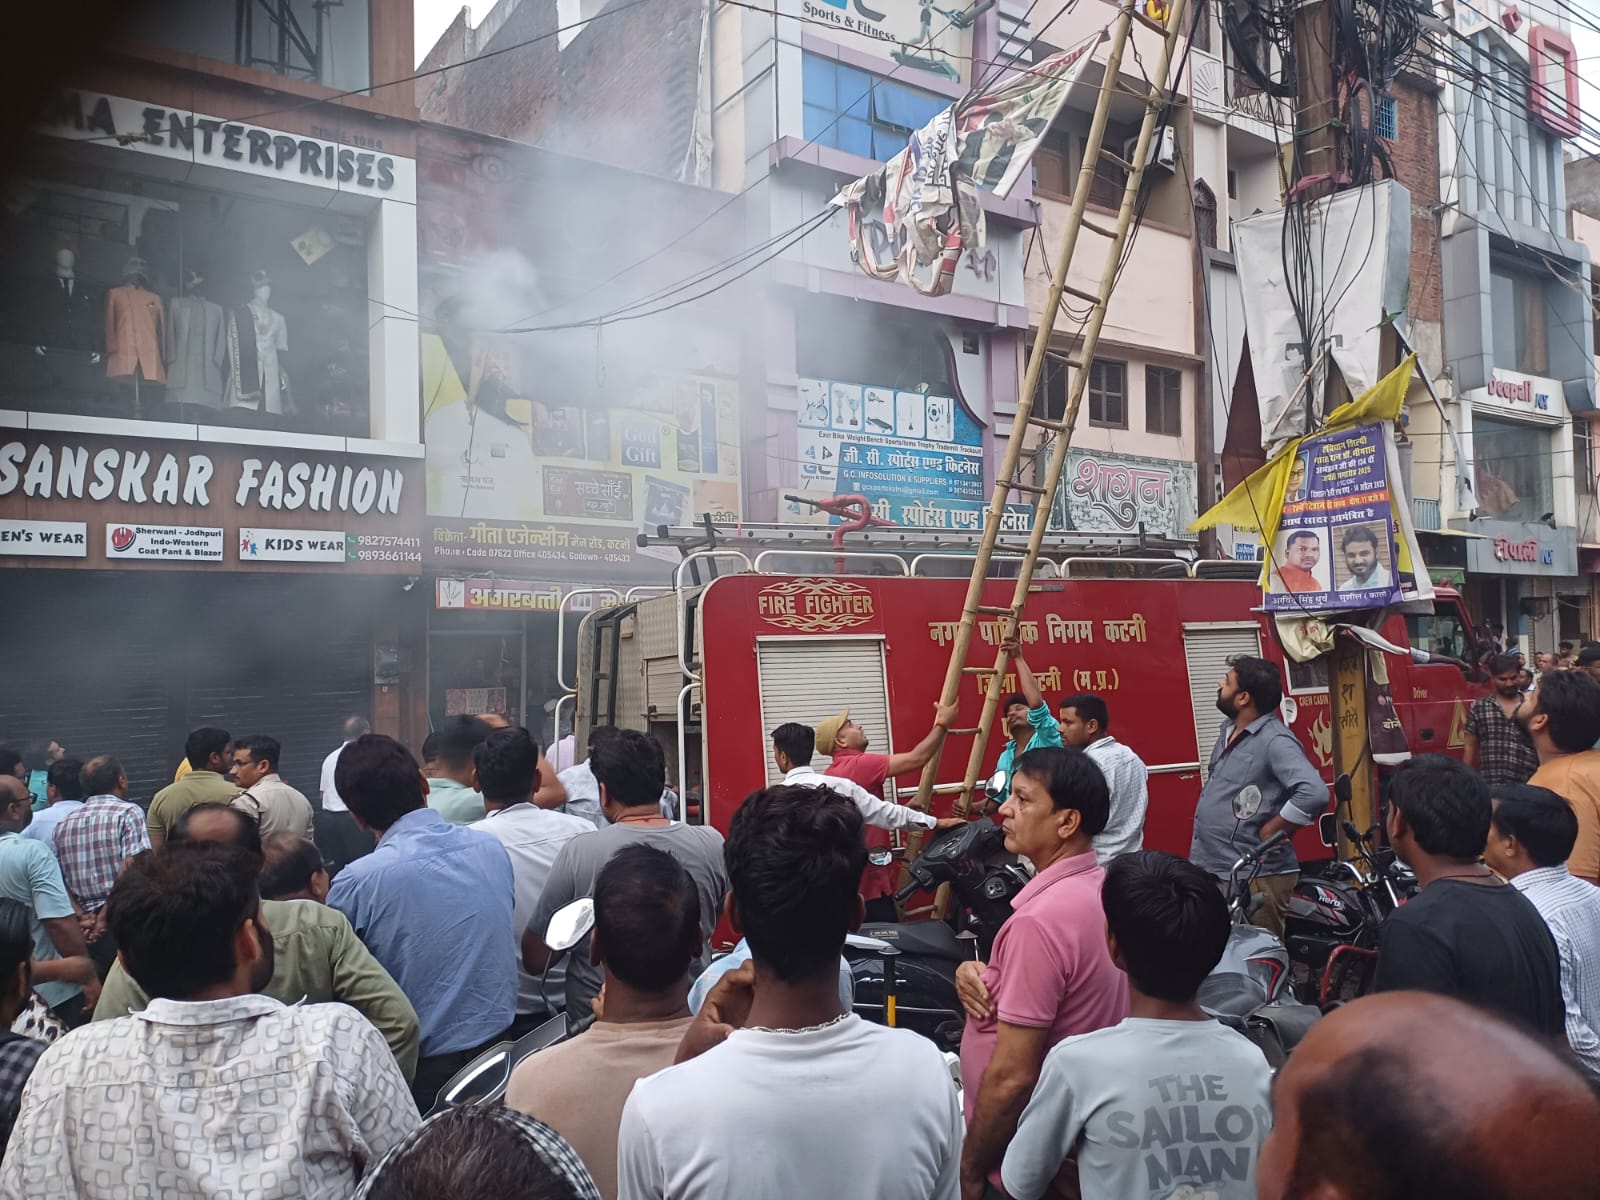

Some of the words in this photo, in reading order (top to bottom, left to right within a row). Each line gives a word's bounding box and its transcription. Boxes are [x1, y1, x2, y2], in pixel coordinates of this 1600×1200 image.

[802, 2, 841, 24] Sports
[843, 16, 855, 28] &
[857, 20, 896, 42] Fitness
[141, 107, 395, 190] ENTERPRISES
[1487, 378, 1531, 404] Deepali
[626, 446, 656, 462] Gift
[843, 446, 862, 464] जी.
[866, 448, 884, 466] सी.
[945, 456, 979, 475] फिटनेस
[0, 441, 215, 507] SANSKAR
[234, 457, 404, 515] FASHION
[858, 472, 905, 482] INFOSOLUTION
[913, 476, 946, 486] SUPPLIERS
[0, 529, 36, 544] EN'S
[39, 531, 85, 545] WEAR
[135, 527, 177, 536] Sherwani
[184, 529, 222, 538] Jodhpuri
[357, 535, 421, 547] 9827574411
[469, 522, 503, 545] गीता
[150, 538, 209, 547] Indo-Western
[264, 538, 304, 551] KIDS
[307, 540, 344, 551] WEAR
[138, 547, 159, 555] Coat
[161, 548, 182, 556] Pant
[185, 548, 192, 556] &
[194, 549, 222, 557] Blazer
[358, 550, 422, 562] 9893661144
[466, 548, 487, 556] Code
[569, 551, 598, 561] Godown
[758, 596, 796, 614] FIRE
[805, 595, 874, 613] FIGHTER
[928, 621, 961, 646] नग
[1045, 613, 1093, 644] निगम
[1103, 612, 1147, 643] कटनी
[1031, 665, 1062, 691] टनी
[1319, 895, 1341, 906] Hero
[1148, 1074, 1228, 1103] THE
[1144, 1146, 1250, 1190] MAN
